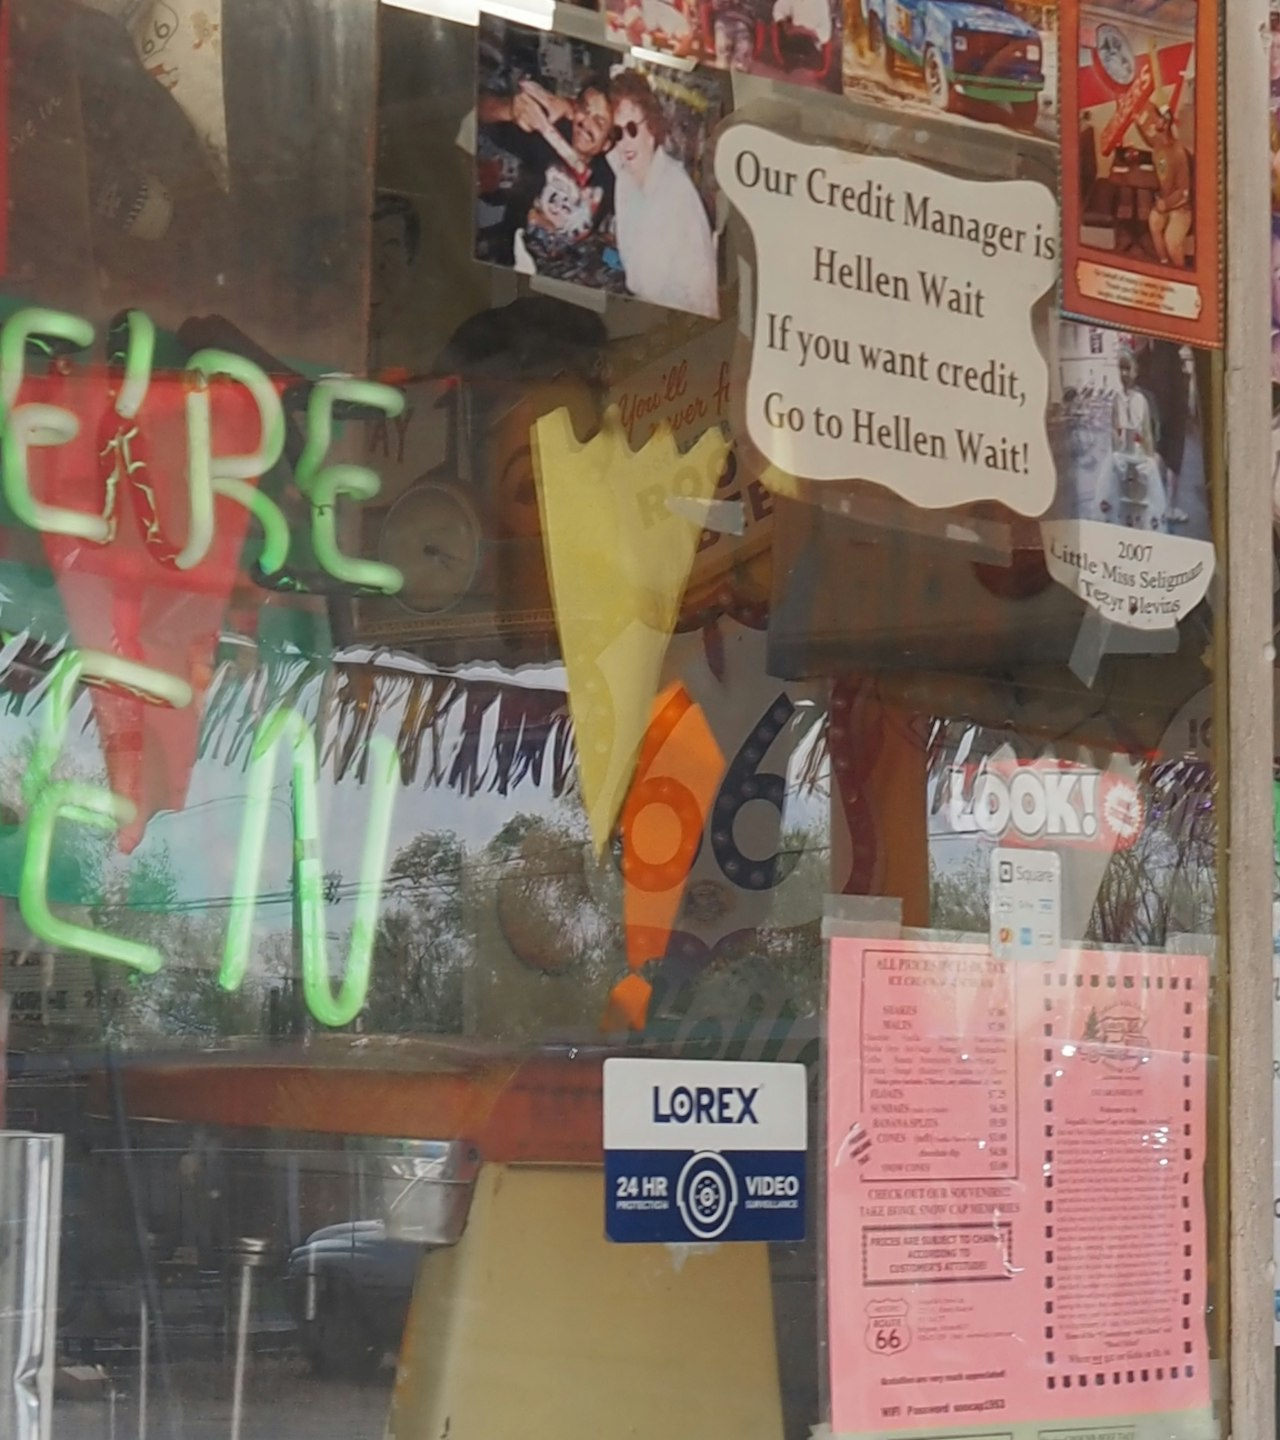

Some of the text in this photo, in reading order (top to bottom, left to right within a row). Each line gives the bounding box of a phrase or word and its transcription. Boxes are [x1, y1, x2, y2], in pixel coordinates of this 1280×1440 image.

[736, 150, 1057, 260] Our Credit Manager is
[813, 245, 985, 319] Hellen Wait
[766, 312, 1026, 407] If you want credit,
[764, 392, 1029, 475] Go to Hellen Wait!
[1050, 538, 1098, 575] Little
[1101, 561, 1136, 589] Miss
[1117, 540, 1153, 563] 2007
[946, 766, 1101, 839] LOOK!
[1017, 866, 1055, 882] Square
[652, 1085, 759, 1125] LOREX
[616, 1176, 668, 1197] 24 HR
[745, 1176, 800, 1197] VIDEO
[867, 1188, 903, 1200] CHECK
[903, 1235, 920, 1246] ARE
[959, 1233, 971, 1245] TO
[872, 1317, 903, 1329] ROUTE
[875, 1327, 902, 1351] 66
